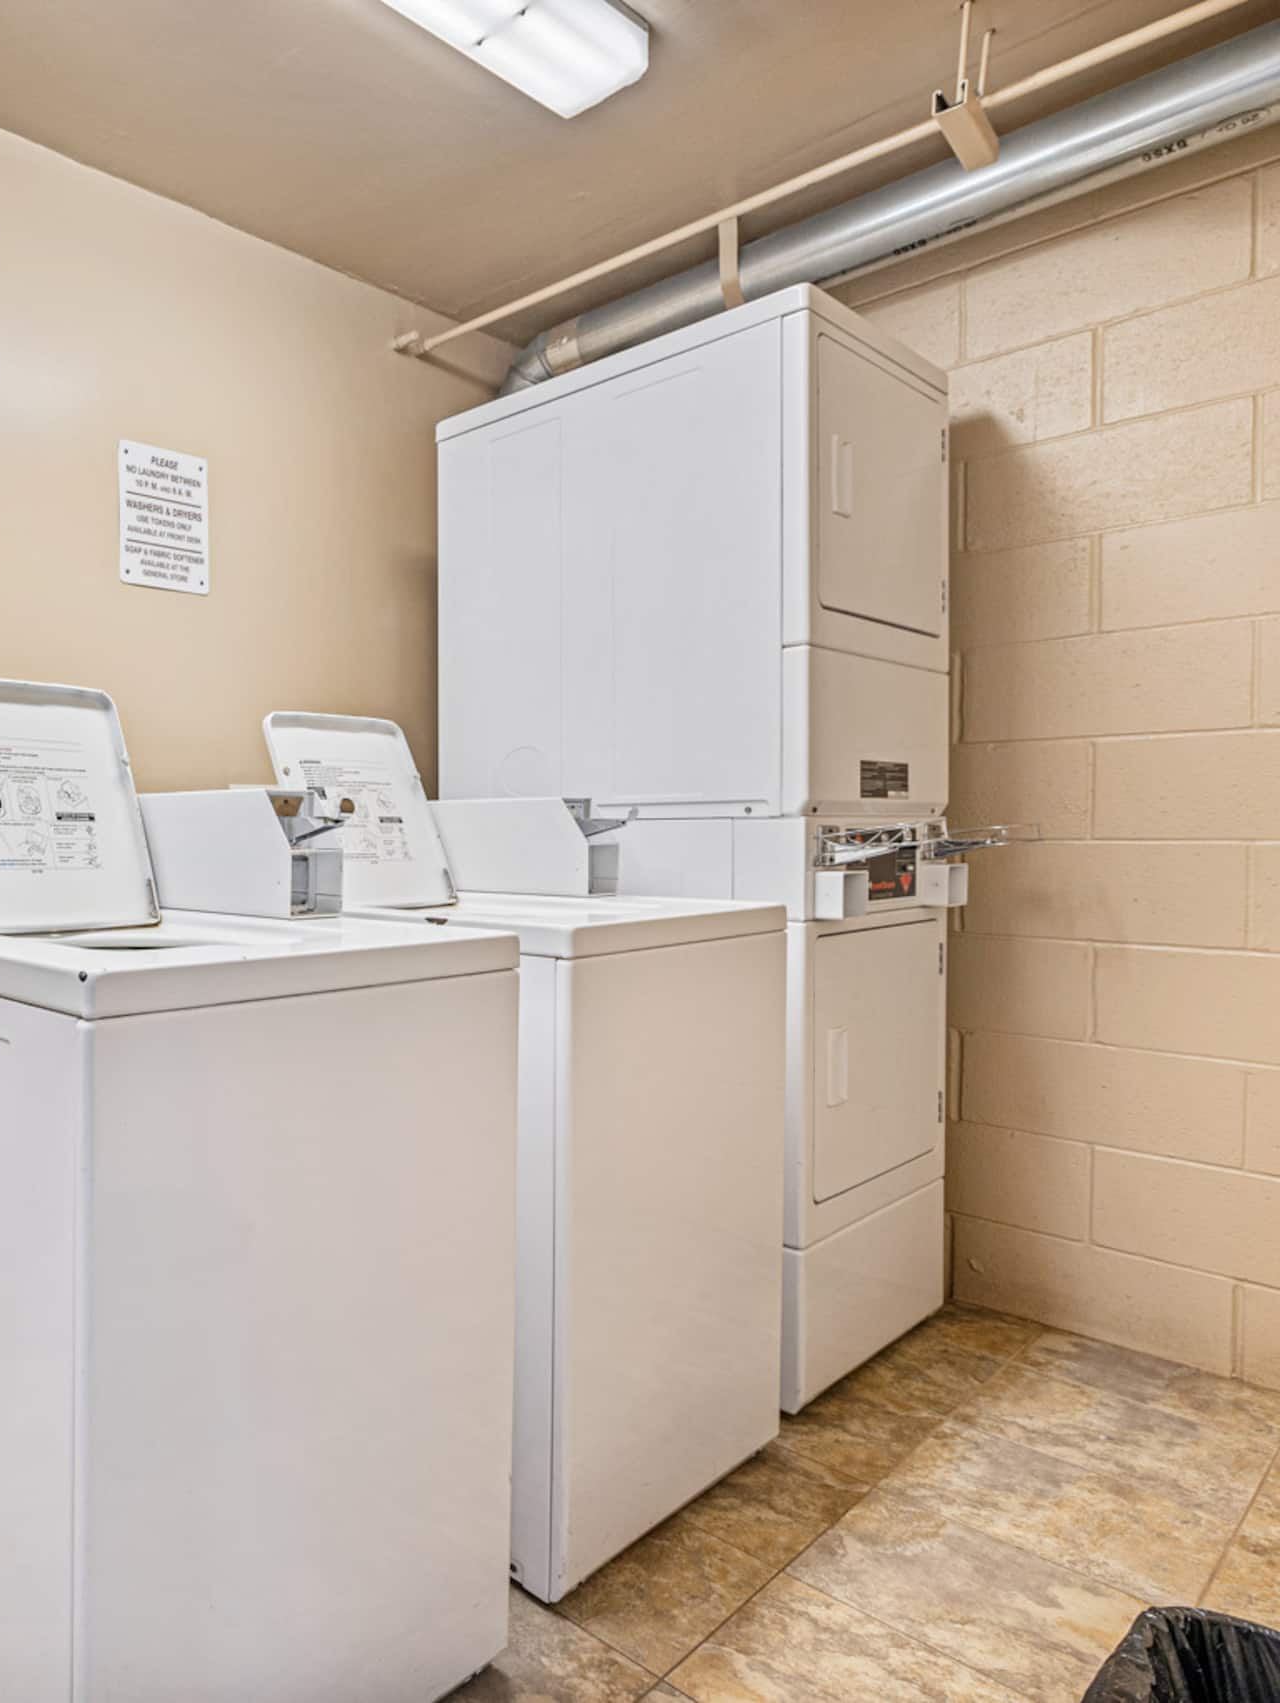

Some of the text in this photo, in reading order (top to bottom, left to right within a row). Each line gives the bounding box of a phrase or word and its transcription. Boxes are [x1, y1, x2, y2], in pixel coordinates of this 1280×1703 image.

[151, 456, 178, 470] PLEASE
[126, 464, 201, 488] NO LAUNDRY BETWEEN
[126, 499, 202, 522] WASHERS & DRYERS
[127, 524, 157, 537] AVAILABLE
[136, 515, 149, 524] USE
[176, 521, 192, 531] ONLY
[124, 544, 142, 554] SOAP
